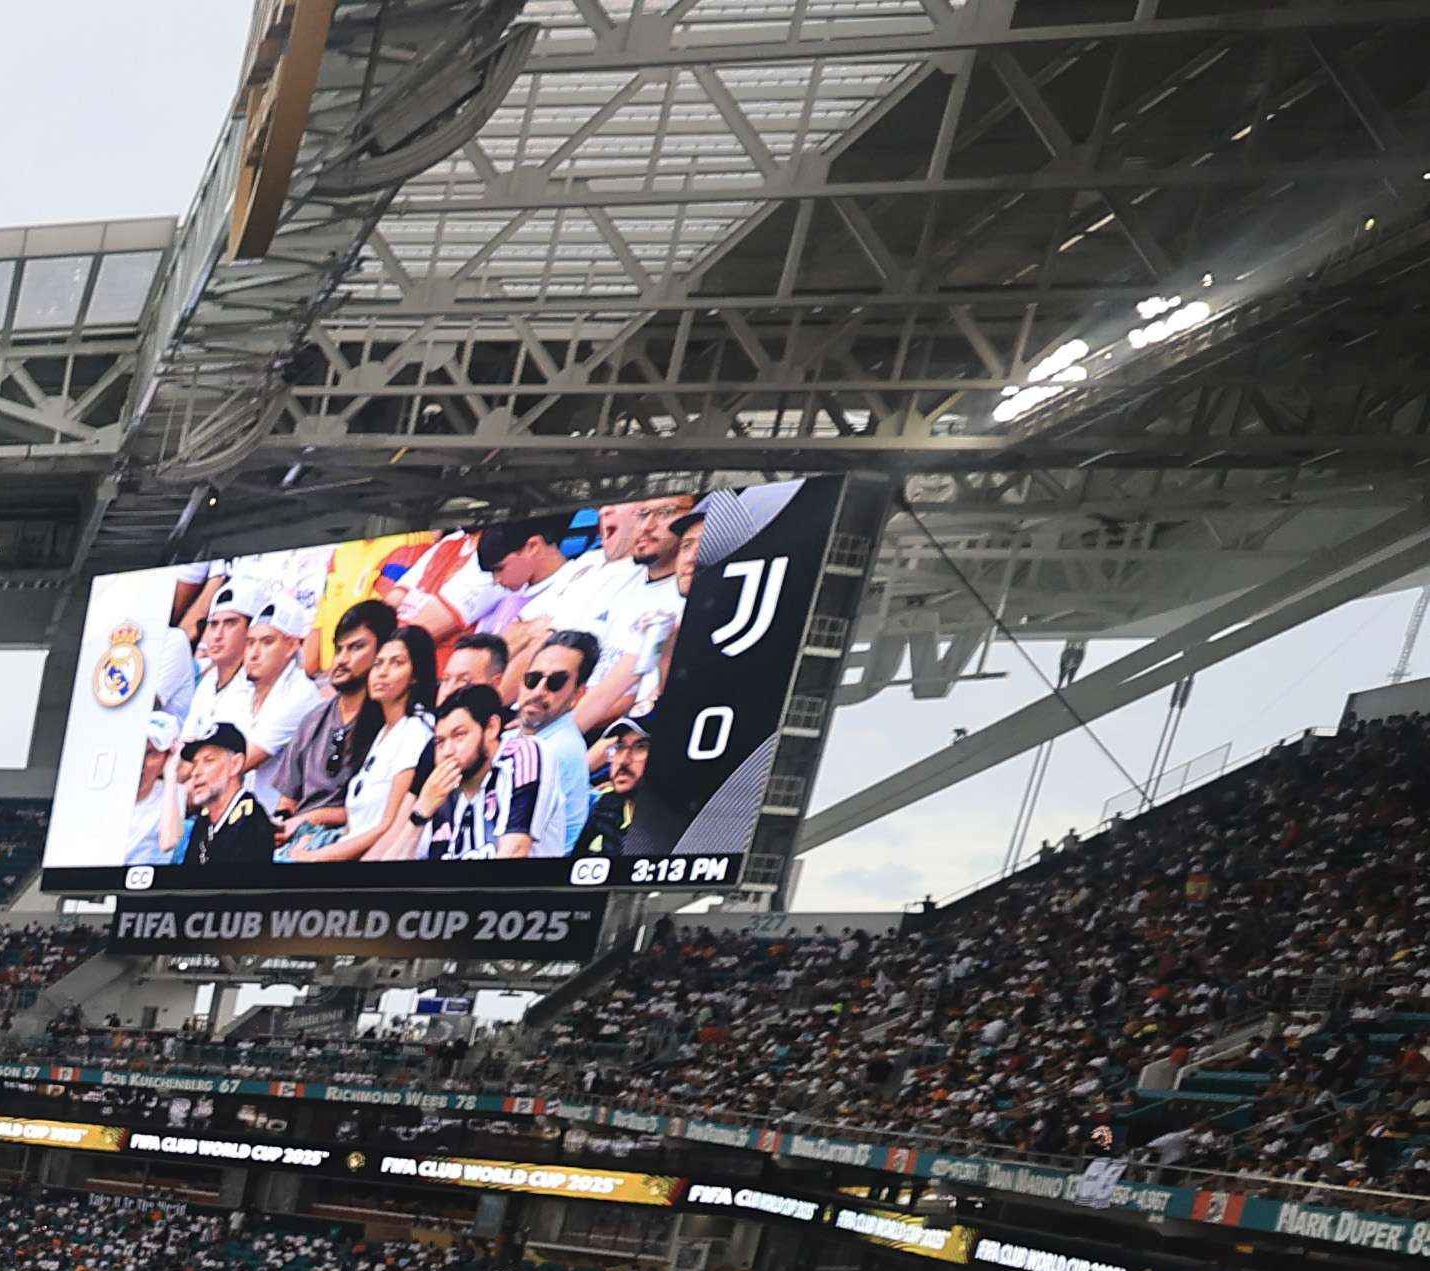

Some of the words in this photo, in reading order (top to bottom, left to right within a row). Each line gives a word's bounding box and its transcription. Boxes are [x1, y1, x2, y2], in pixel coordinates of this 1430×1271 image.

[689, 706, 734, 761] 0
[631, 860, 687, 882] 3:13
[692, 859, 729, 881] PM
[117, 910, 179, 940] FIFA
[185, 910, 263, 940] CLUB
[271, 909, 387, 941] WORLD
[395, 909, 466, 940] CUP
[456, 1094, 477, 1110] 78
[381, 1157, 417, 1174] FIFA
[418, 1160, 462, 1178] CLUB
[463, 1164, 524, 1184] WORLD
[528, 1168, 564, 1187] CUP
